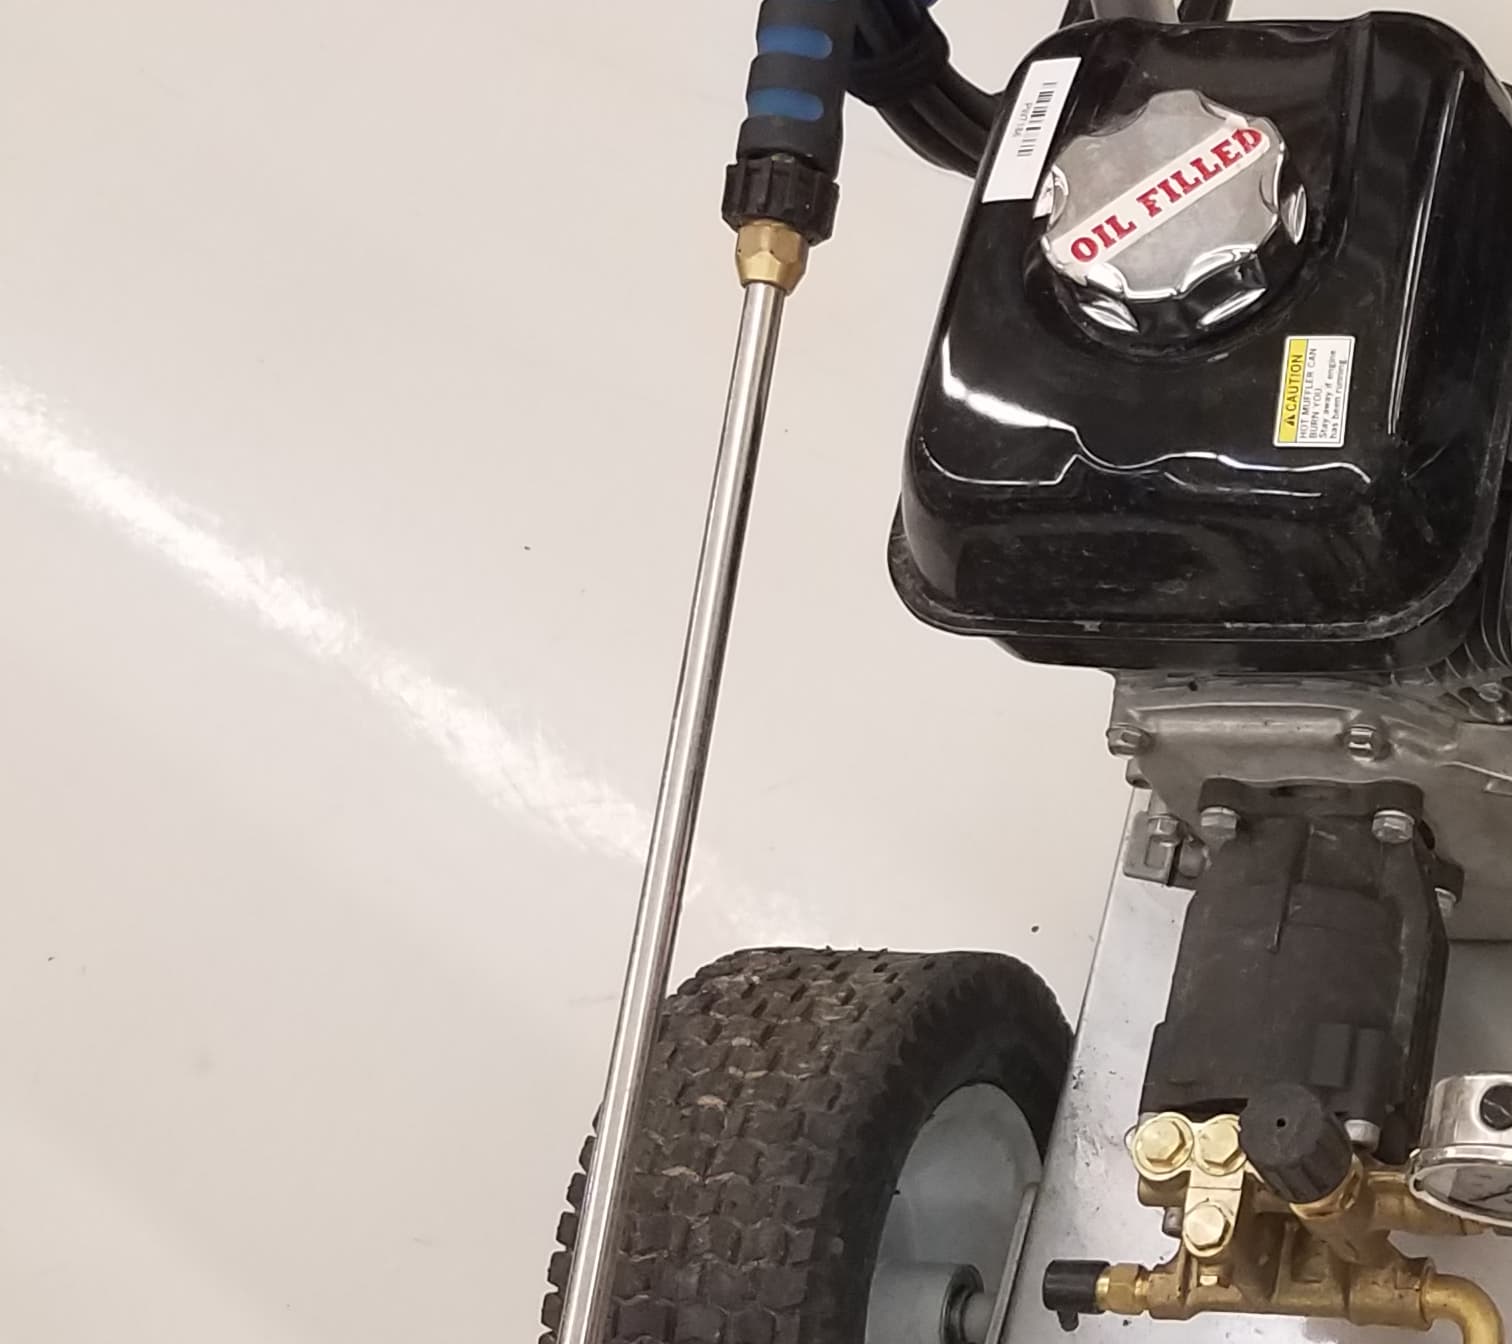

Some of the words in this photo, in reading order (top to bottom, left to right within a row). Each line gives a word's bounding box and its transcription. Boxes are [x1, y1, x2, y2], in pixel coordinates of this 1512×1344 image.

[1070, 215, 1137, 262] OIL
[1136, 127, 1262, 218] FILLED
[1307, 348, 1317, 369] CAN
[1328, 350, 1337, 380] engine
[1286, 354, 1304, 412] CAUTION
[1302, 371, 1313, 416] MUFFLER
[1324, 382, 1332, 390] if
[1323, 392, 1334, 415] away
[1332, 396, 1342, 420] been
[1299, 419, 1309, 439] HOT
[1309, 411, 1319, 439] BURN
[1318, 418, 1331, 439] Stay
[1330, 423, 1339, 439] has
